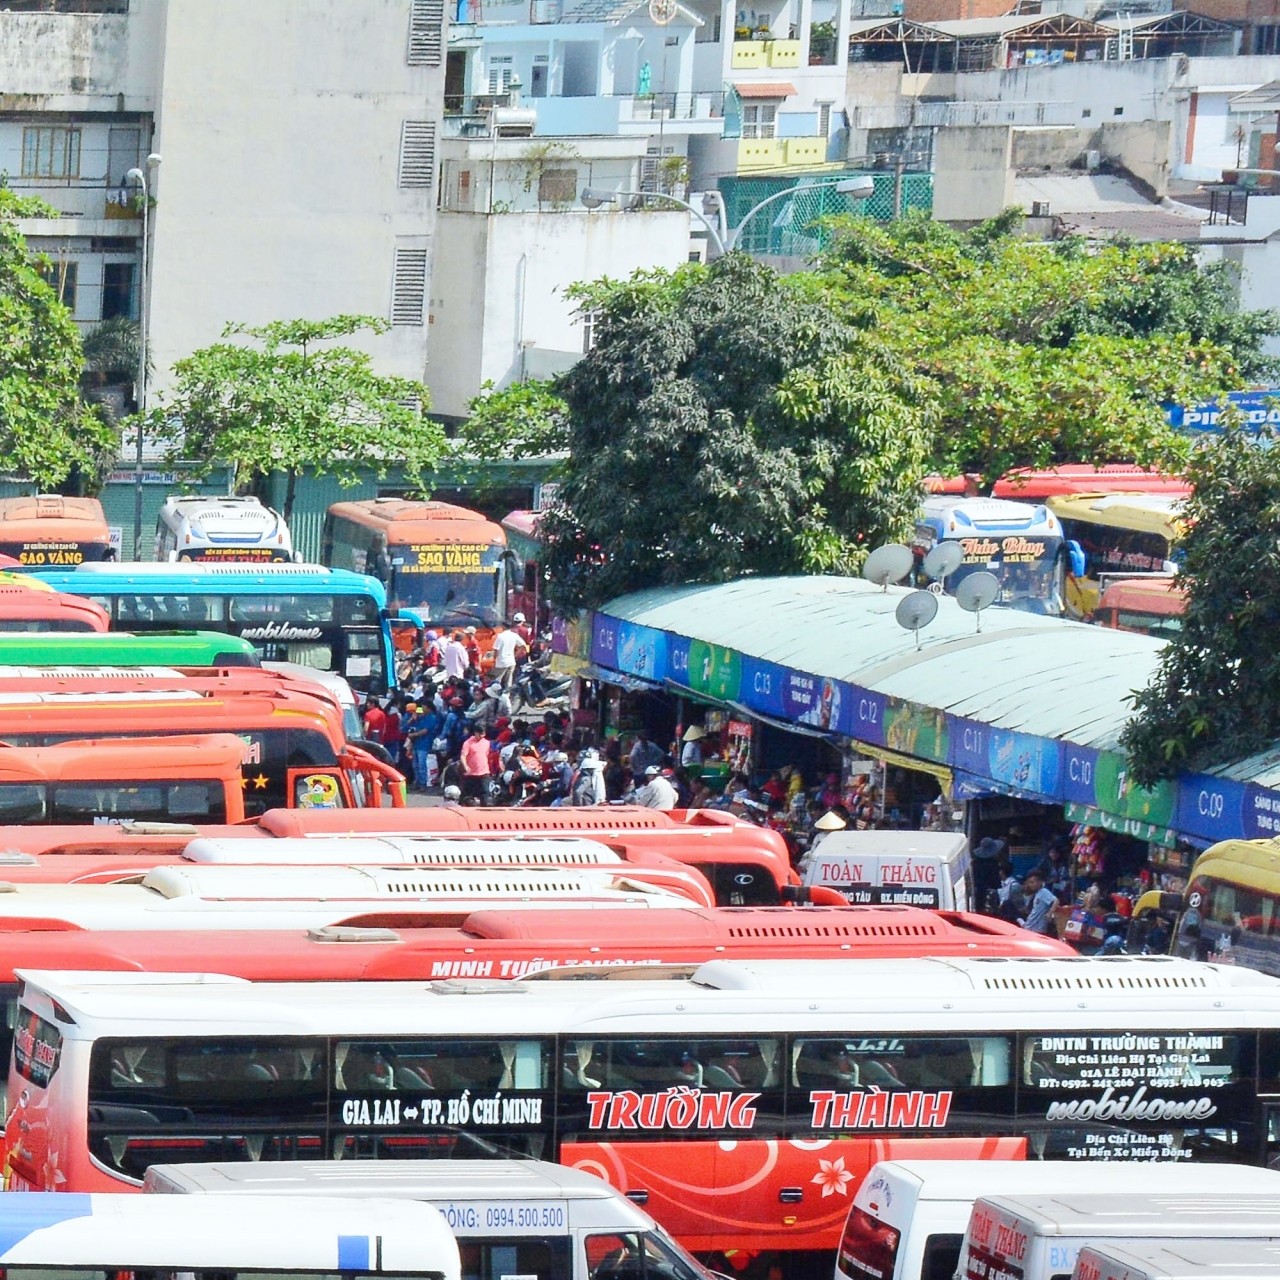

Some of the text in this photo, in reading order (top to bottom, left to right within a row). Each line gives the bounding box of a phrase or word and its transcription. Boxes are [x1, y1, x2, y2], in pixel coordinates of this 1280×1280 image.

[19, 552, 45, 565] SAO
[418, 552, 442, 565] SAO
[241, 621, 323, 640] mobihome
[753, 671, 771, 695] C.13
[859, 699, 877, 724] C.12
[963, 728, 982, 755] C.11
[1069, 757, 1090, 785] C.10
[1198, 790, 1224, 818] C.09
[822, 862, 863, 881] TOÀN
[431, 961, 492, 977] MINH
[1091, 1032, 1224, 1051] TRƯỜNG THÀNH
[1101, 1053, 1126, 1064] Liên
[1129, 1053, 1145, 1066] Hệ
[1169, 1053, 1190, 1064] Gia
[1191, 1053, 1211, 1064] Lai
[1104, 1065, 1120, 1078] LÊ
[1125, 1066, 1145, 1080] ĐẠI
[1146, 1065, 1184, 1078] HÀNH
[1039, 1078, 1061, 1088] ĐT:
[341, 1088, 543, 1125] GIA LAI TP. HỒ CHÍ MINH
[586, 1083, 954, 1130] TRƯỜNG THÀNH
[1045, 1086, 1218, 1121] mobihome
[1113, 1148, 1129, 1158] Xe
[485, 1206, 564, 1228] 0994.500.500
